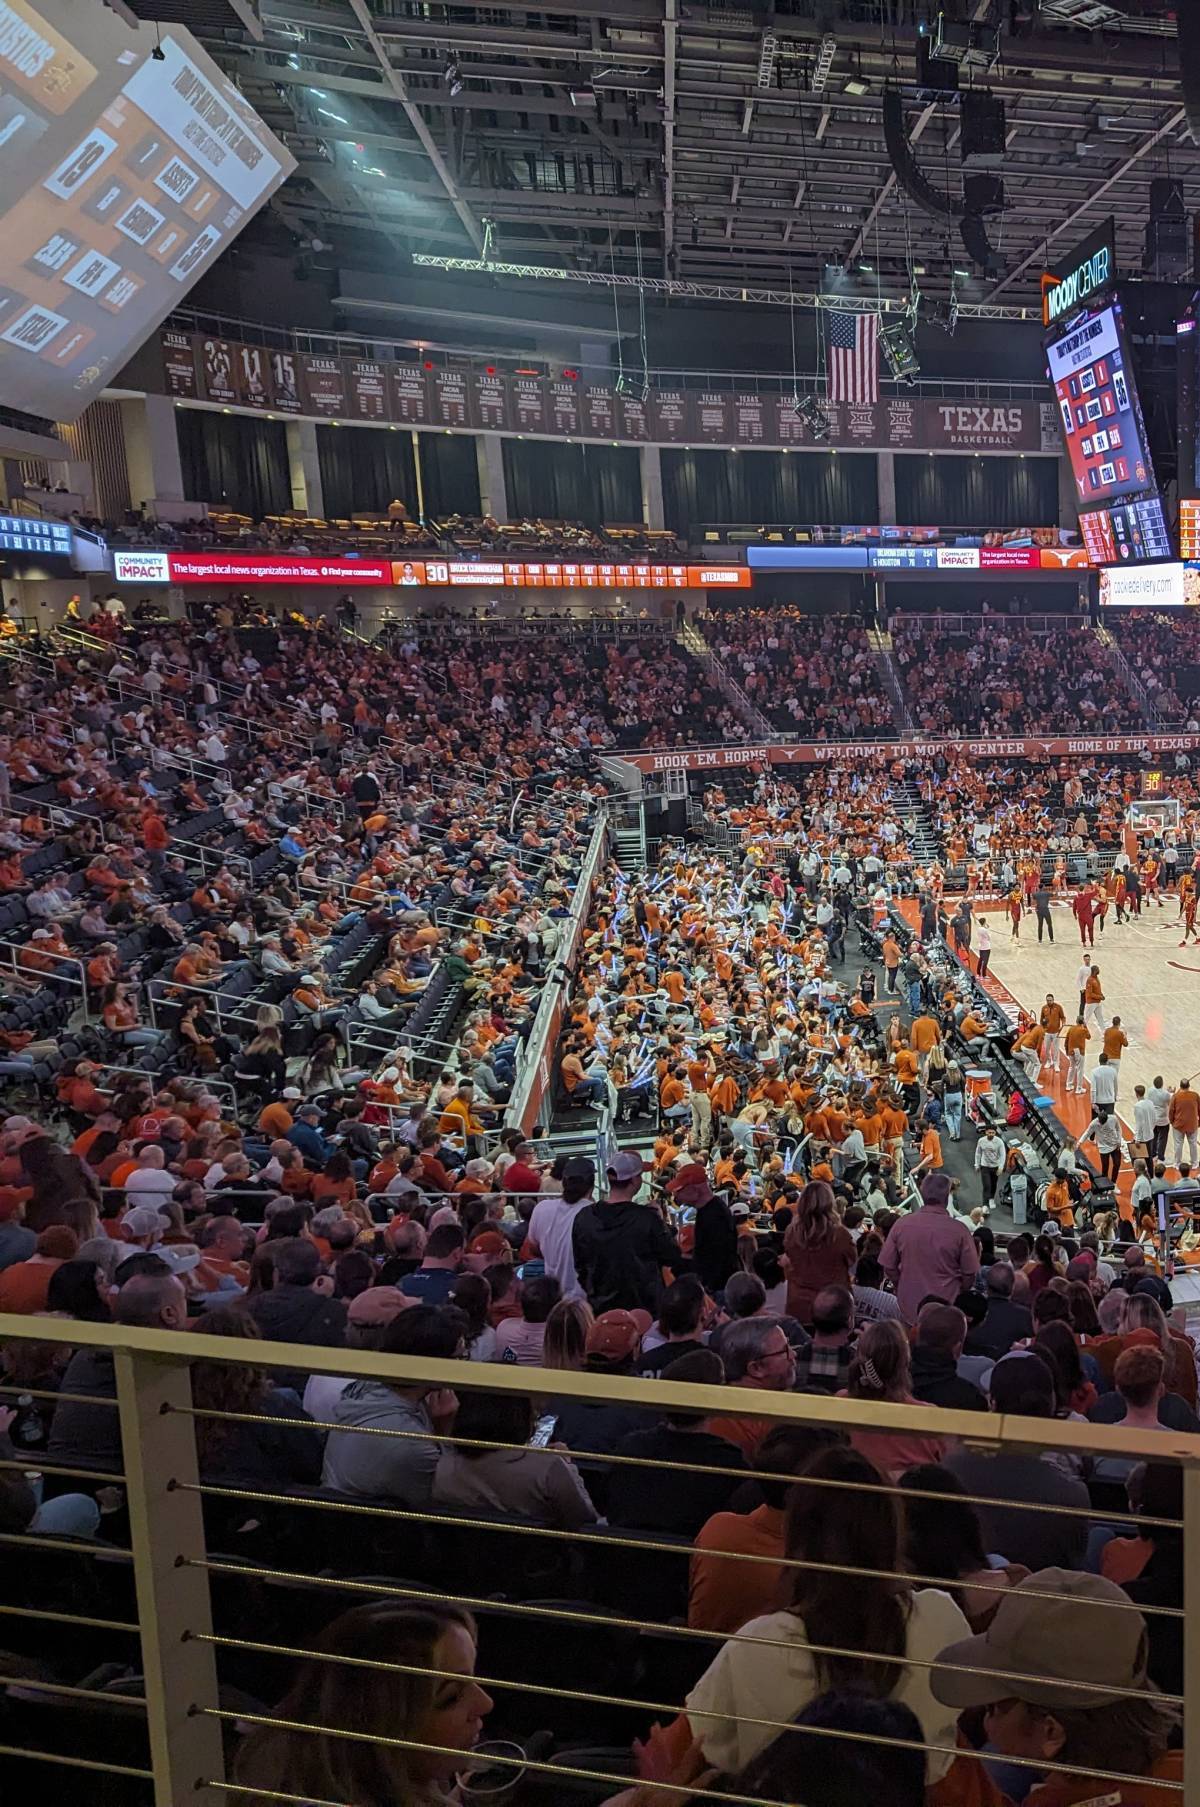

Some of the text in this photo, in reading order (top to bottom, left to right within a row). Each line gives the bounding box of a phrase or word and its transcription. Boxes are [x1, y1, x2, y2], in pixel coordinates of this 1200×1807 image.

[160, 162, 194, 197] ASSISTS
[1048, 246, 1108, 320] MOODY CENTER
[166, 333, 187, 345] TEXAS
[241, 348, 261, 379] 11
[273, 354, 295, 385] 15
[312, 359, 335, 369] TEXAS
[938, 406, 1022, 433] TEXAS
[951, 435, 1012, 444] BASKETBALL
[118, 557, 163, 565] COMMUNITY
[941, 557, 975, 565] IMPACT
[119, 566, 164, 577] IMPACT
[173, 563, 188, 573] The
[188, 563, 214, 576] largest
[214, 564, 231, 574] local
[231, 567, 250, 575] news
[250, 566, 291, 577] organization
[292, 567, 299, 576] in
[299, 567, 320, 576] Texas.
[353, 569, 383, 578] community
[425, 565, 448, 582] 30
[1114, 577, 1173, 596] cookiedelivery.com
[814, 746, 886, 759] WELCOME
[891, 745, 909, 756] TO
[1068, 740, 1097, 752] HOME
[1100, 739, 1117, 751] OF
[1119, 738, 1142, 750] THE
[1153, 737, 1191, 750] TEXAS
[653, 756, 690, 768] HOOK
[724, 750, 767, 763] HORNS
[1145, 780, 1158, 791] 30
